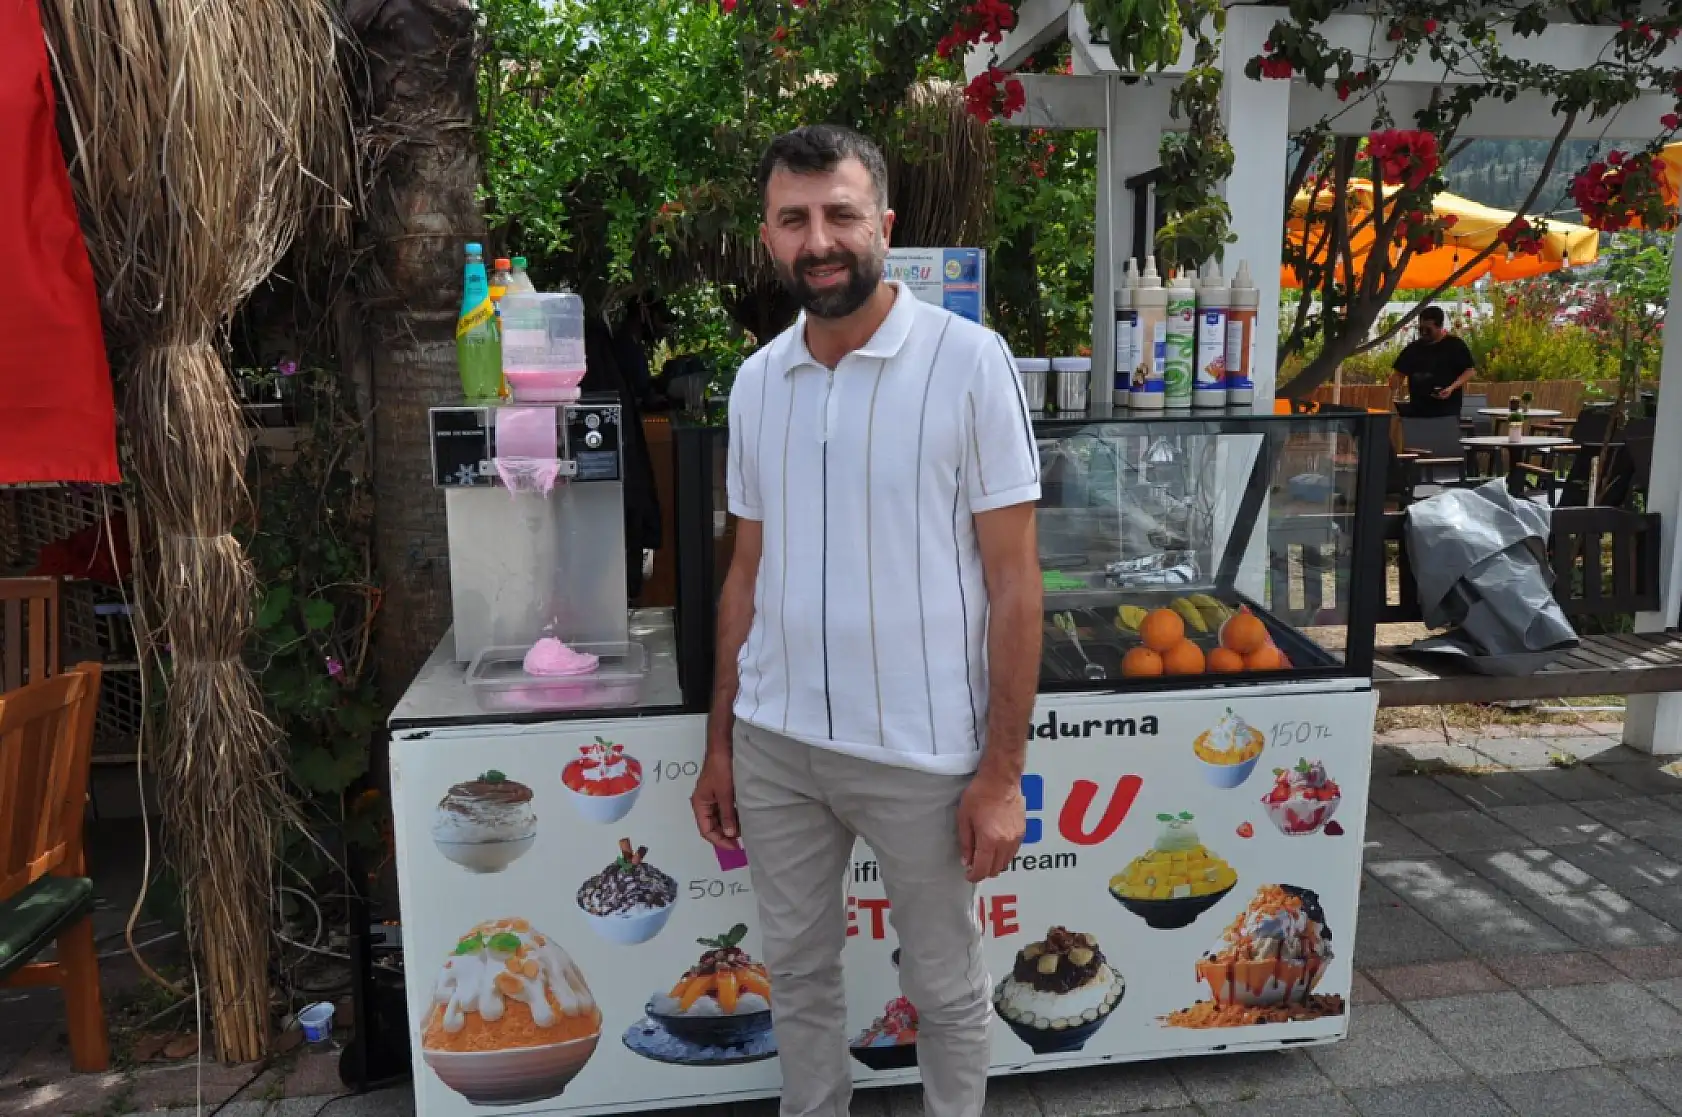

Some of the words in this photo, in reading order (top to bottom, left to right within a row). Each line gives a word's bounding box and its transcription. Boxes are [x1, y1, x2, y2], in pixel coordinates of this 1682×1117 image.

[1270, 720, 1312, 748] 150
[1314, 724, 1333, 739] TL
[652, 760, 699, 783] 100
[1001, 852, 1077, 873] ream
[689, 879, 724, 900] 50
